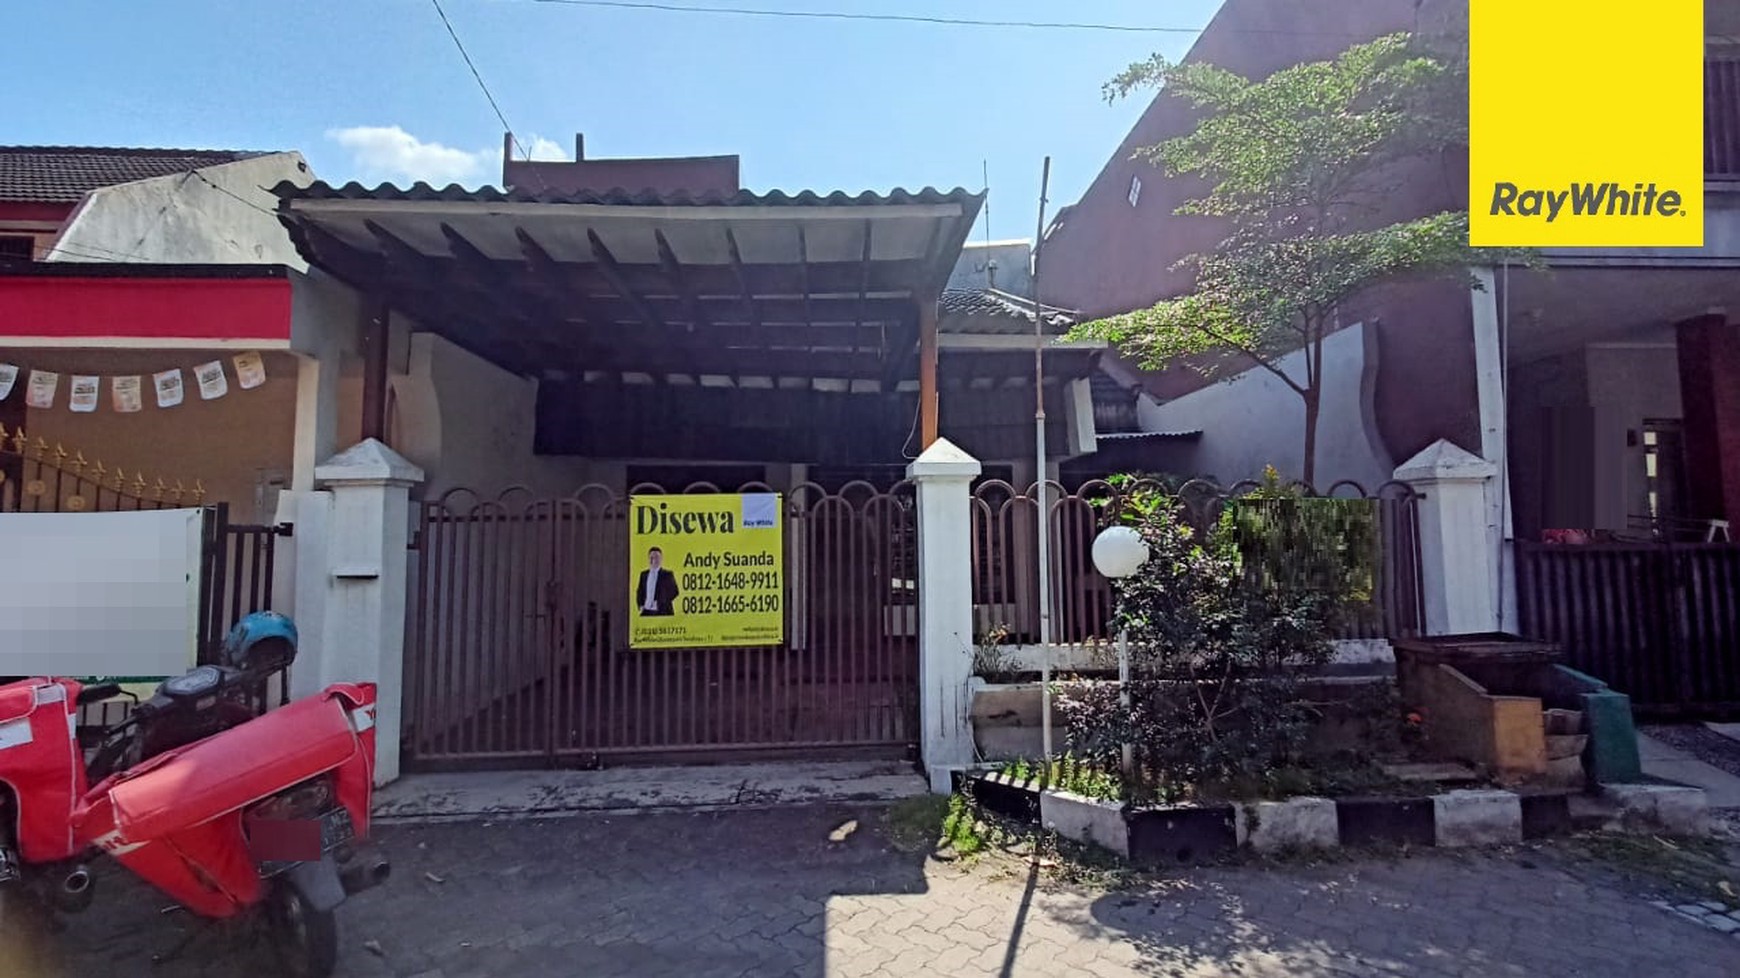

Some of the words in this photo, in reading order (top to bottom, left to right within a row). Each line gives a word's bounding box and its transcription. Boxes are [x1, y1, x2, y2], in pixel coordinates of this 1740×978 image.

[636, 503, 734, 535] Disewa
[684, 552, 721, 569] Andy
[723, 550, 774, 566] Suanda
[682, 572, 778, 591] 0812-1648-9911
[682, 594, 779, 614] 0812-1665-6190
